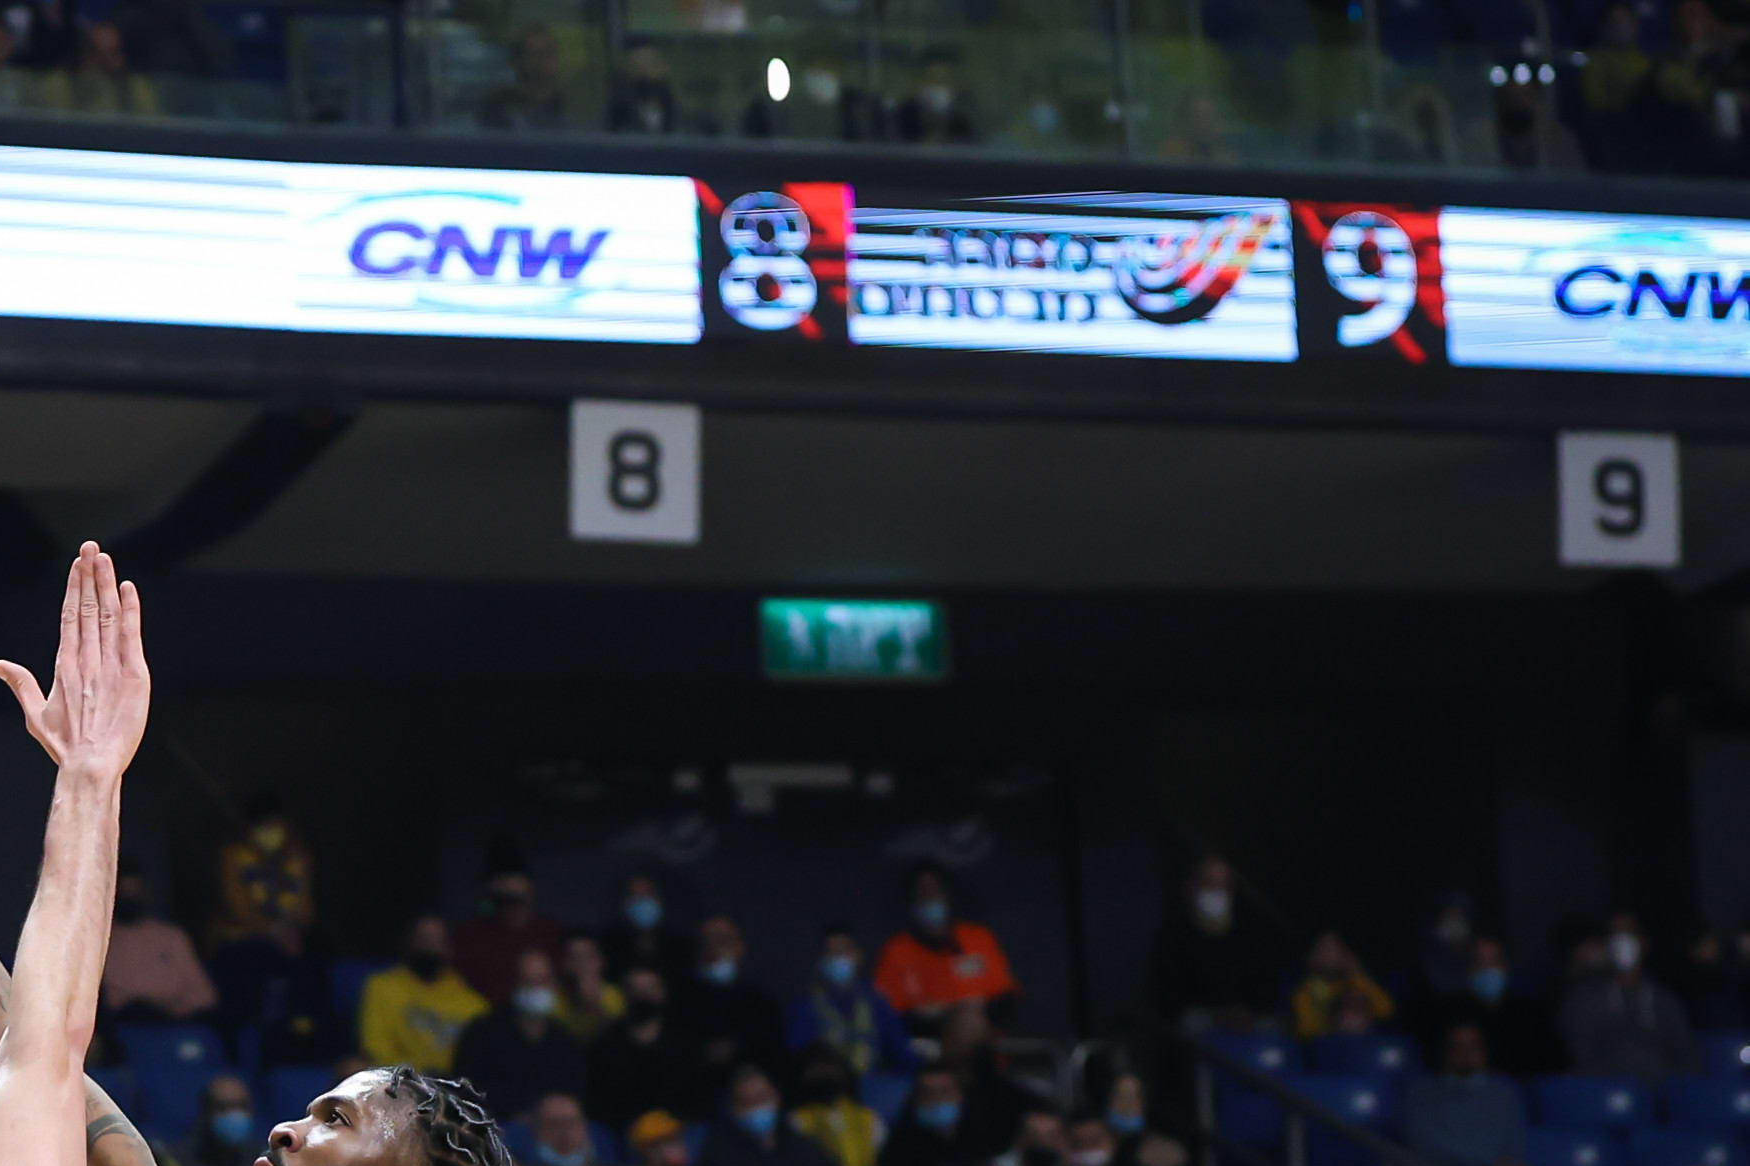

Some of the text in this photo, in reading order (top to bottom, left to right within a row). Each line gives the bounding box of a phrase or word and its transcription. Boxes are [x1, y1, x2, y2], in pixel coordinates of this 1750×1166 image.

[350, 221, 611, 279] CNW
[718, 191, 817, 331] 8
[1322, 210, 1418, 347] 9
[608, 429, 661, 512] 8
[1595, 458, 1644, 538] 9
